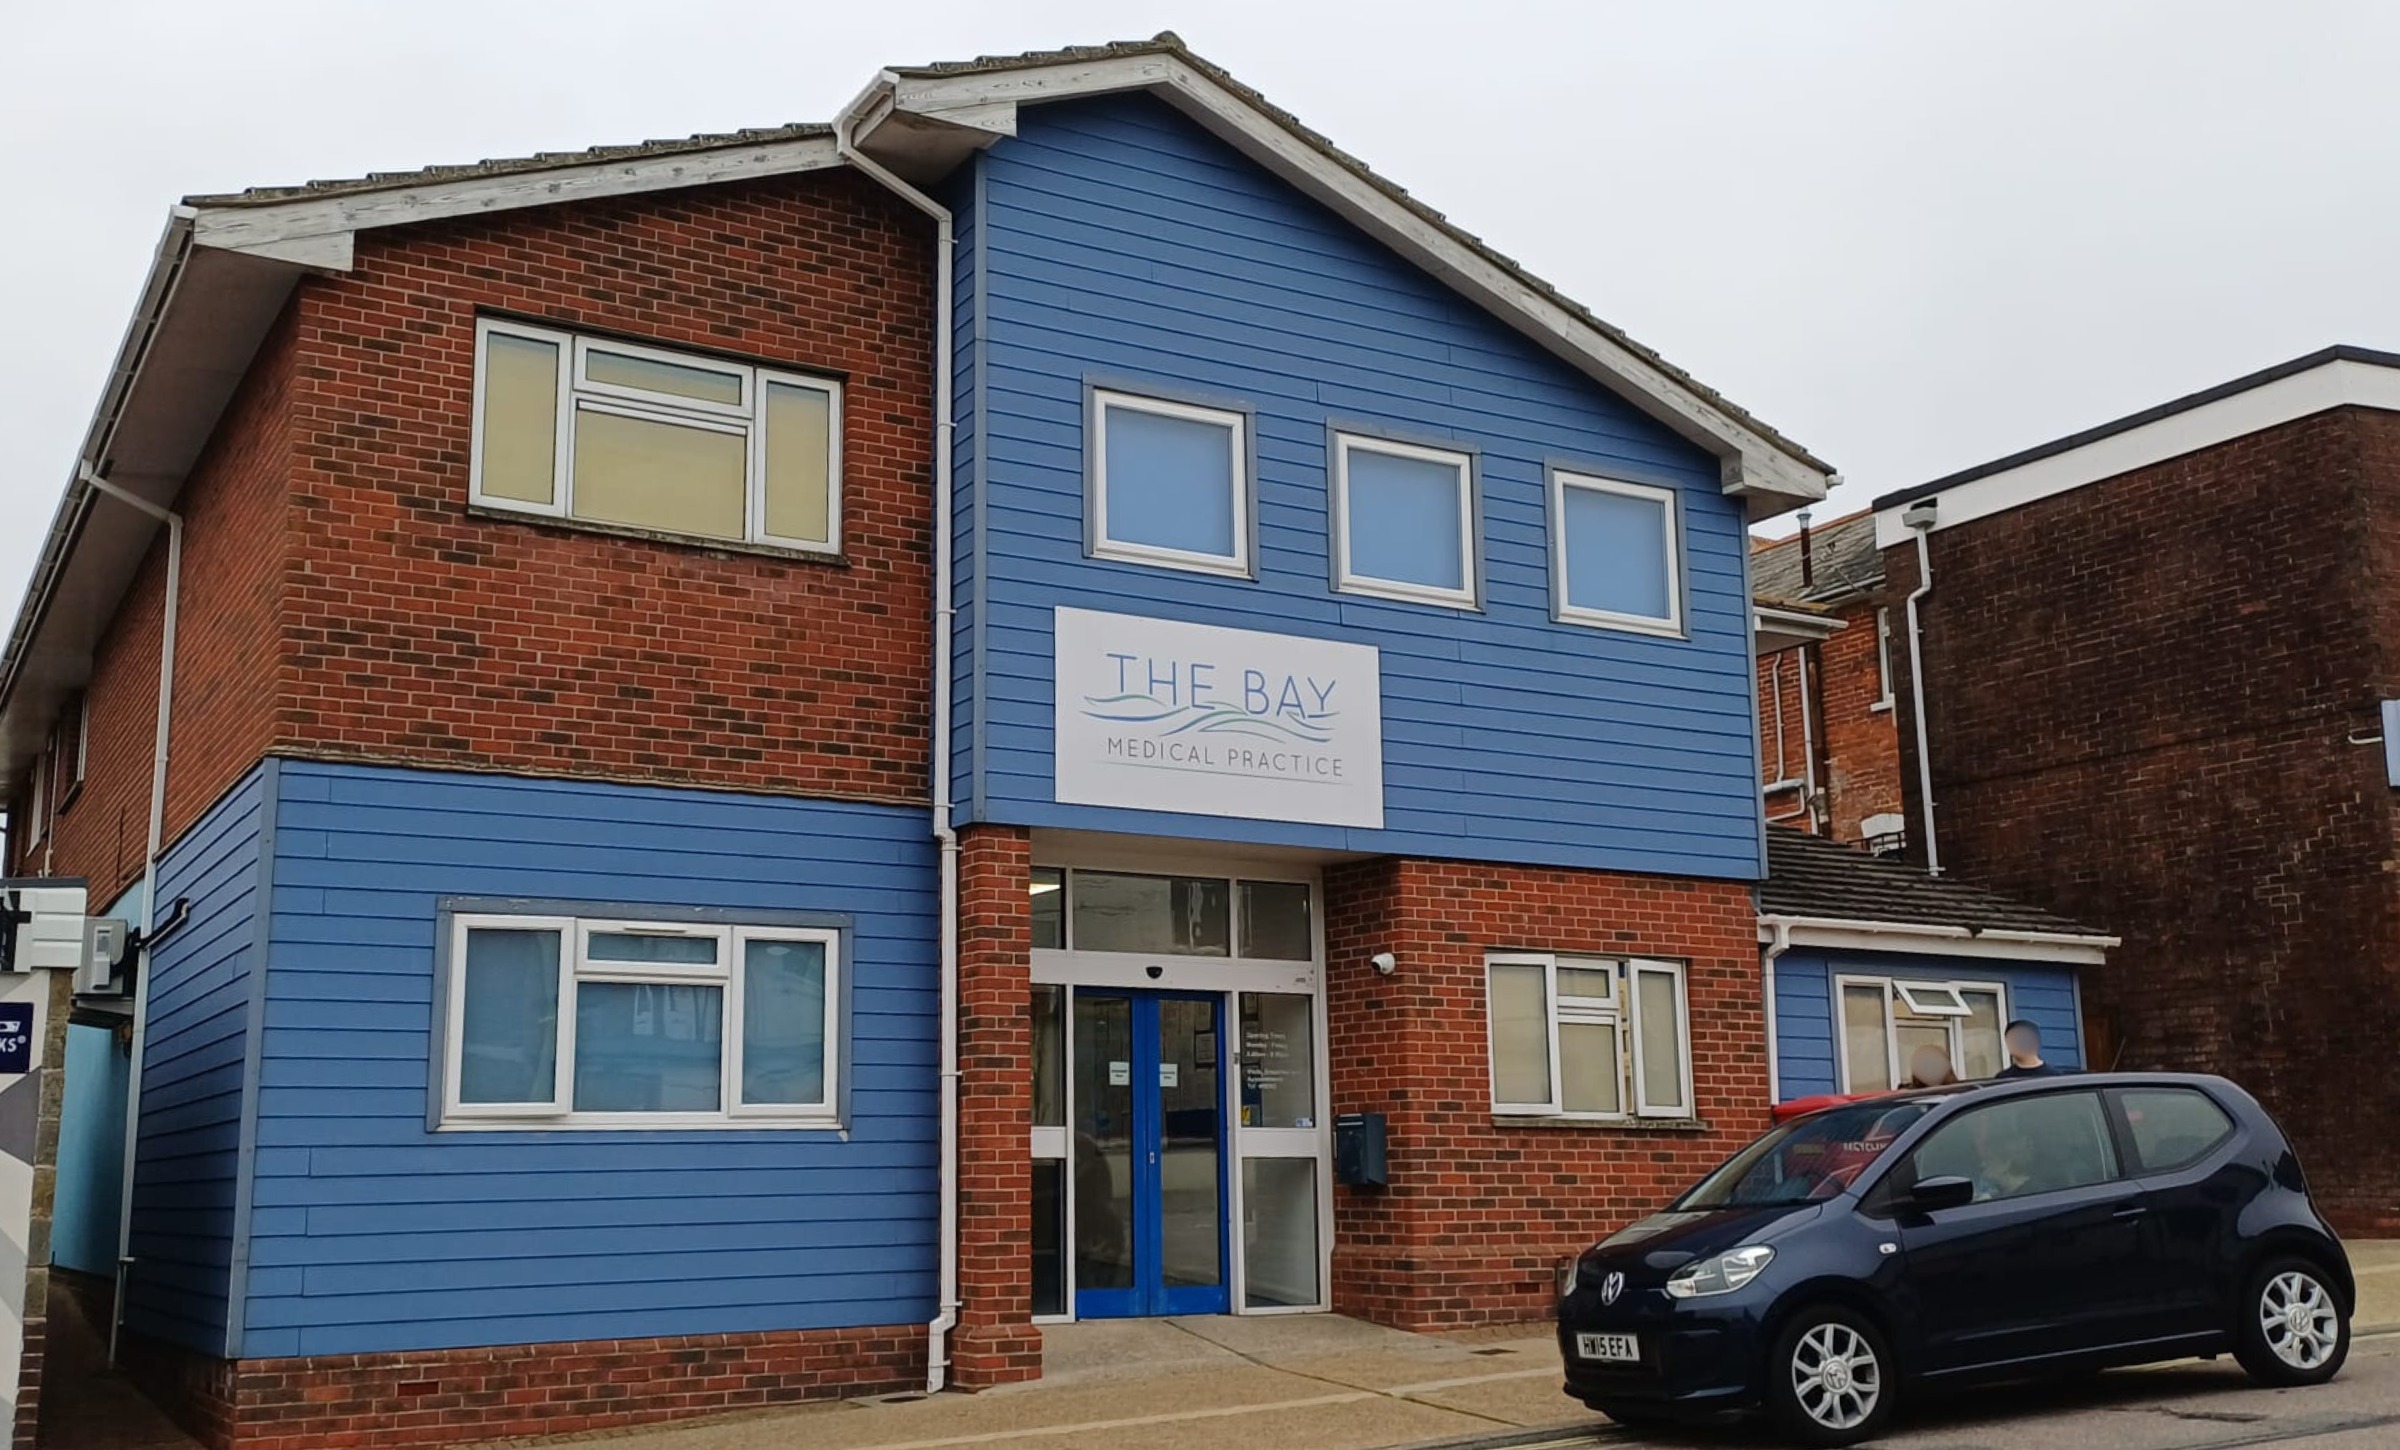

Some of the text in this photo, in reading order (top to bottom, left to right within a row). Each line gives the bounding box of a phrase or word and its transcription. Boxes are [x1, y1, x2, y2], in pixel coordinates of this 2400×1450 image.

[1106, 653, 1337, 719] THE BAY
[1107, 736, 1344, 778] MEDICAL PRACTICE
[1608, 1336, 1633, 1358] EFA
